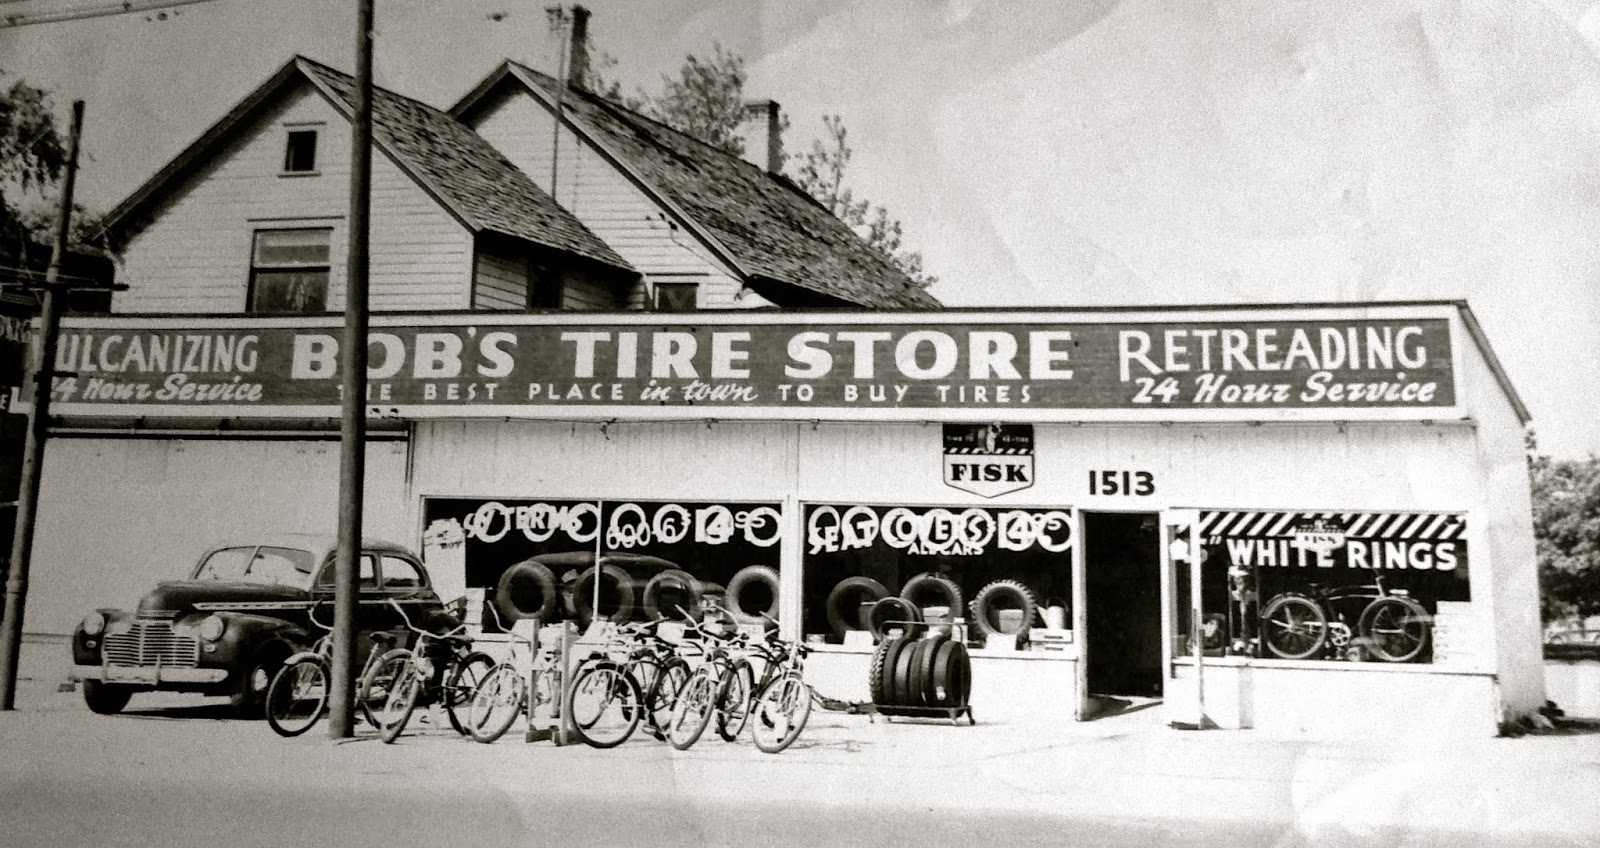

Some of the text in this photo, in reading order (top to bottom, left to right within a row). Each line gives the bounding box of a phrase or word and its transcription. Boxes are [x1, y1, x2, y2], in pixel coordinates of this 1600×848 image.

[291, 326, 1074, 380] BOB'S TIRE STORE
[1118, 326, 1427, 382] RETREADING
[82, 378, 151, 400] Hour
[156, 373, 263, 400] Service
[424, 383, 498, 400] BEST
[528, 382, 624, 400] PLACE
[640, 379, 672, 401] in
[681, 379, 759, 402] town
[778, 384, 814, 401] TO
[844, 384, 908, 402] BUY
[937, 385, 1031, 403] TIRES
[1131, 371, 1437, 403] 24 Hour Service
[950, 463, 1028, 482] FISK
[1089, 470, 1155, 496] 1513
[1347, 541, 1458, 571] RINGS
